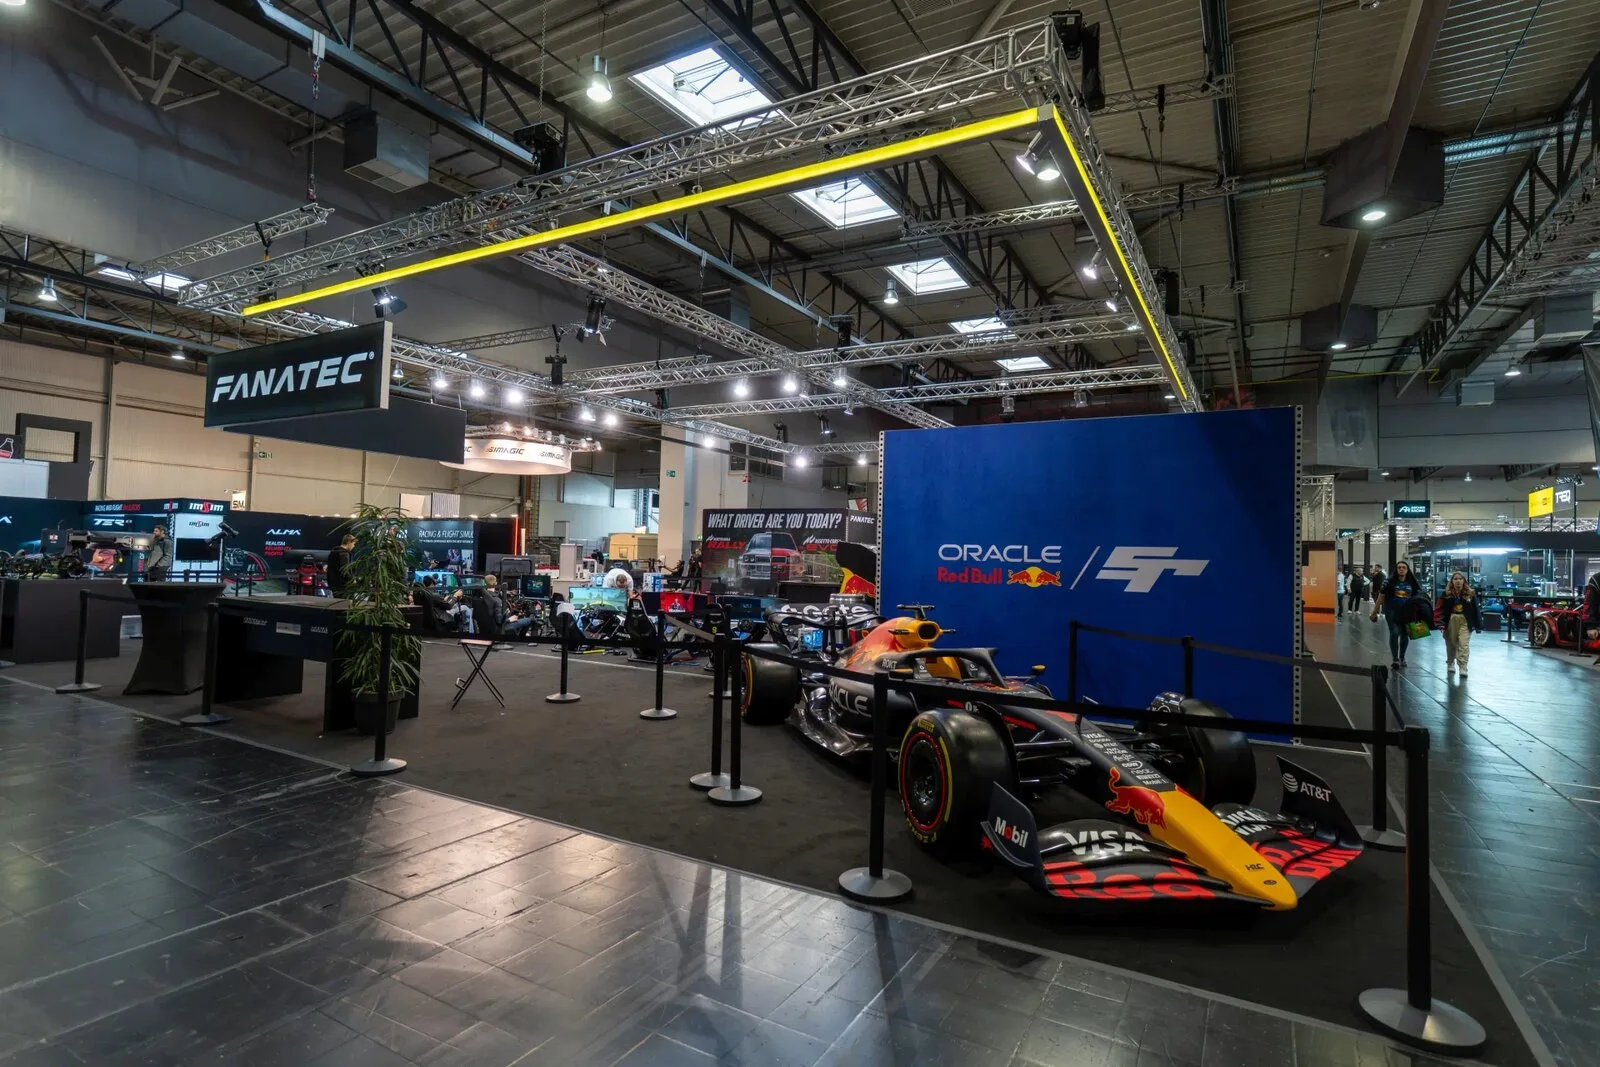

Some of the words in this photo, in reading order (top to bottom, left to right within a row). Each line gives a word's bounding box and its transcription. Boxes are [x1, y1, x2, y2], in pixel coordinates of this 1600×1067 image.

[487, 445, 525, 455] SIMAGIC
[540, 451, 565, 461] SIMAGIC
[707, 513, 734, 529] WHAT
[734, 513, 765, 529] DRIVER
[765, 513, 786, 529] ARE
[785, 513, 803, 529] YOU
[804, 513, 843, 529] TODAY?
[850, 515, 876, 524] FANATEC
[938, 544, 1062, 563] ORACLE
[937, 566, 969, 584] Red
[970, 567, 1003, 585] Bull
[882, 658, 898, 671] ROKT
[1300, 781, 1332, 802] AT&T
[1220, 809, 1272, 836] VISA
[995, 817, 1029, 849] Mobil
[1063, 830, 1150, 856] VISA
[1245, 863, 1264, 871] HRC
[1043, 857, 1216, 899] Red
